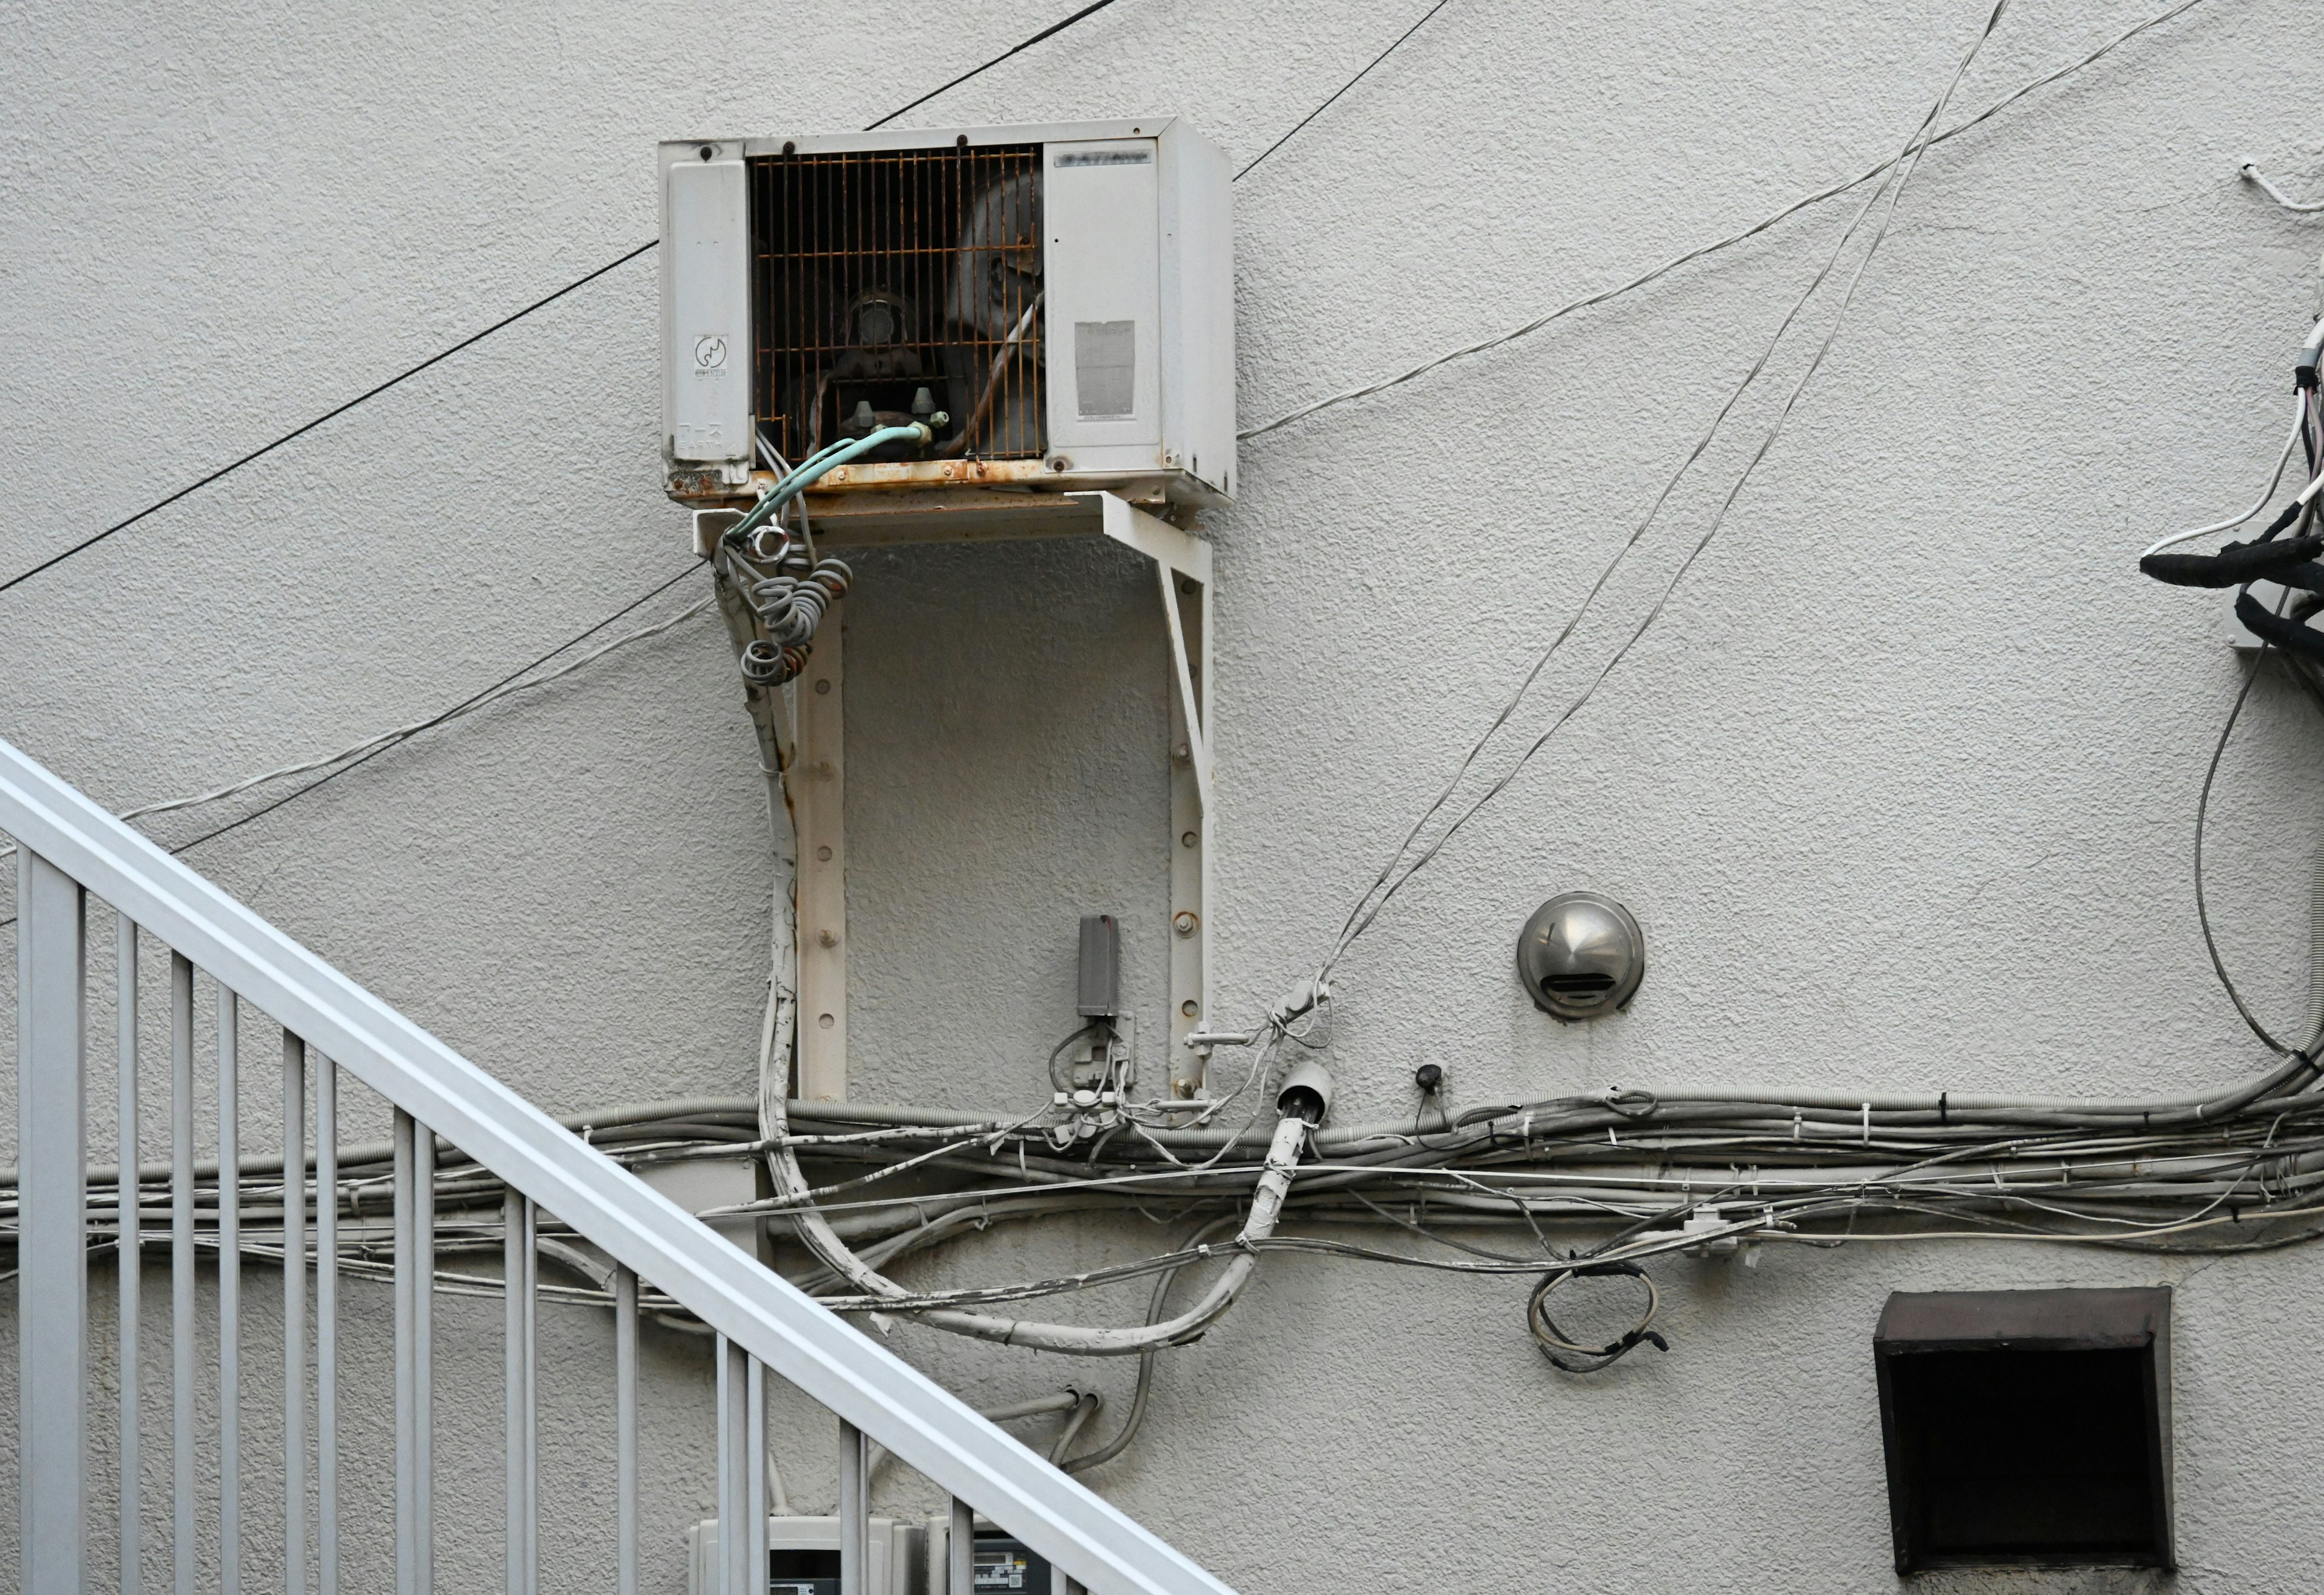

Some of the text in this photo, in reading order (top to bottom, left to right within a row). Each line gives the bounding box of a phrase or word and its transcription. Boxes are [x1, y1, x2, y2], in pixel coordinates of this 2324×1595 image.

[678, 422, 722, 437] アース
[678, 441, 722, 450] EARTH
